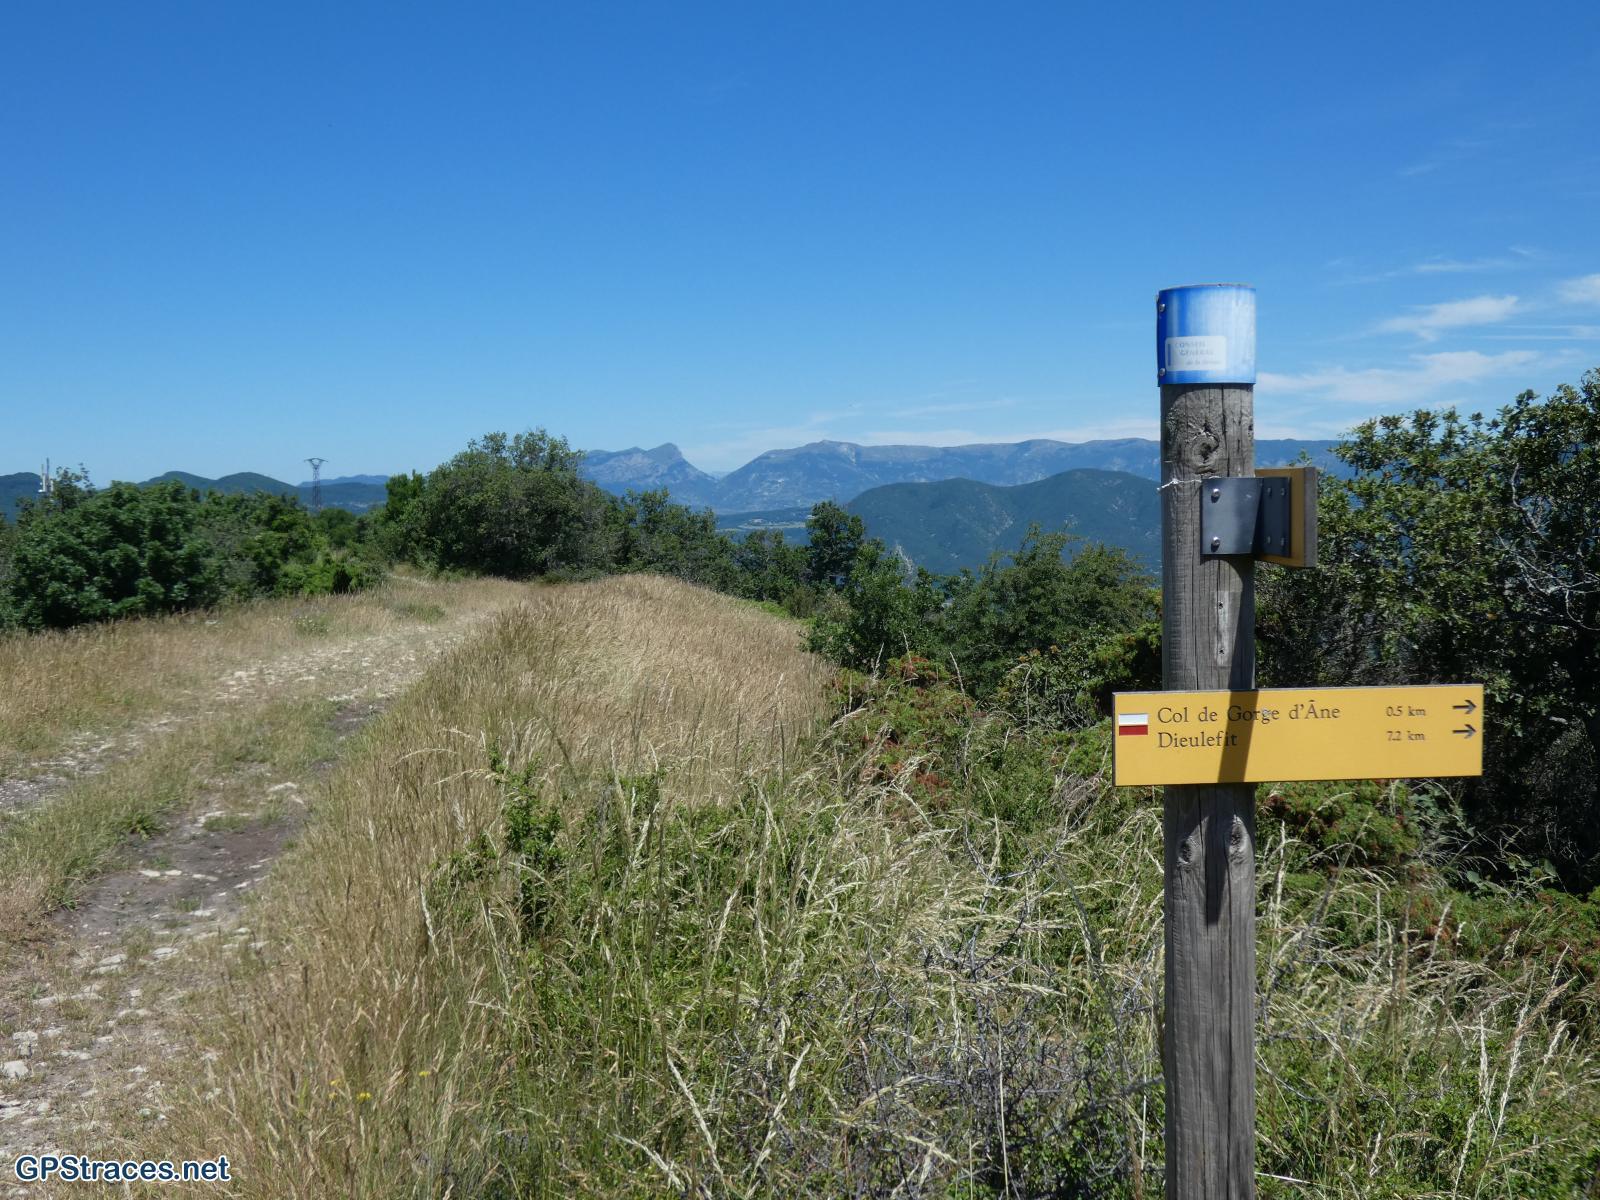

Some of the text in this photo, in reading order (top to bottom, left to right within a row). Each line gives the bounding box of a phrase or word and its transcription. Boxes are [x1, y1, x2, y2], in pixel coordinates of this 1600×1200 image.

[1157, 699, 1340, 724] Col de Gorge d'Âne
[1408, 705, 1426, 717] km
[1157, 730, 1238, 748] Dieulefit
[1407, 730, 1425, 742] km
